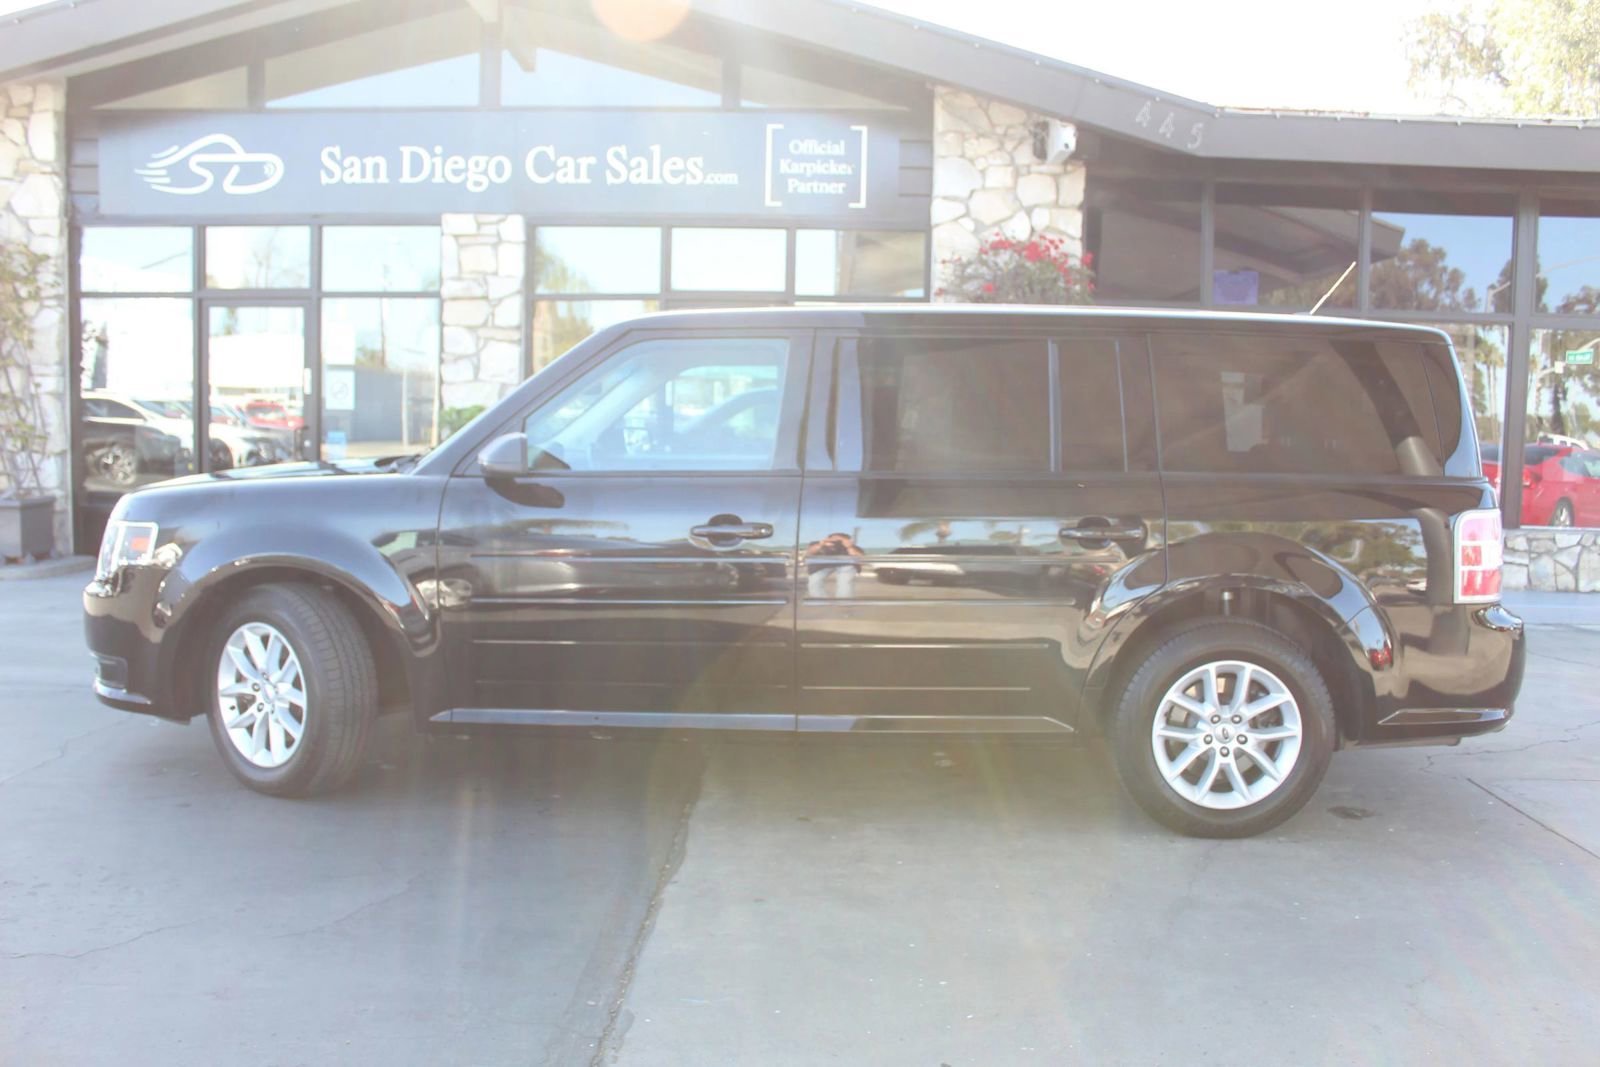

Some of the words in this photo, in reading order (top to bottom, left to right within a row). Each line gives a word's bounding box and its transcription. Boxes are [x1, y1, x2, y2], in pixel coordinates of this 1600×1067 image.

[788, 139, 846, 157] Official
[320, 145, 390, 185] San
[399, 146, 512, 193] Diego
[525, 145, 597, 185] Car
[787, 177, 847, 195] Partner
